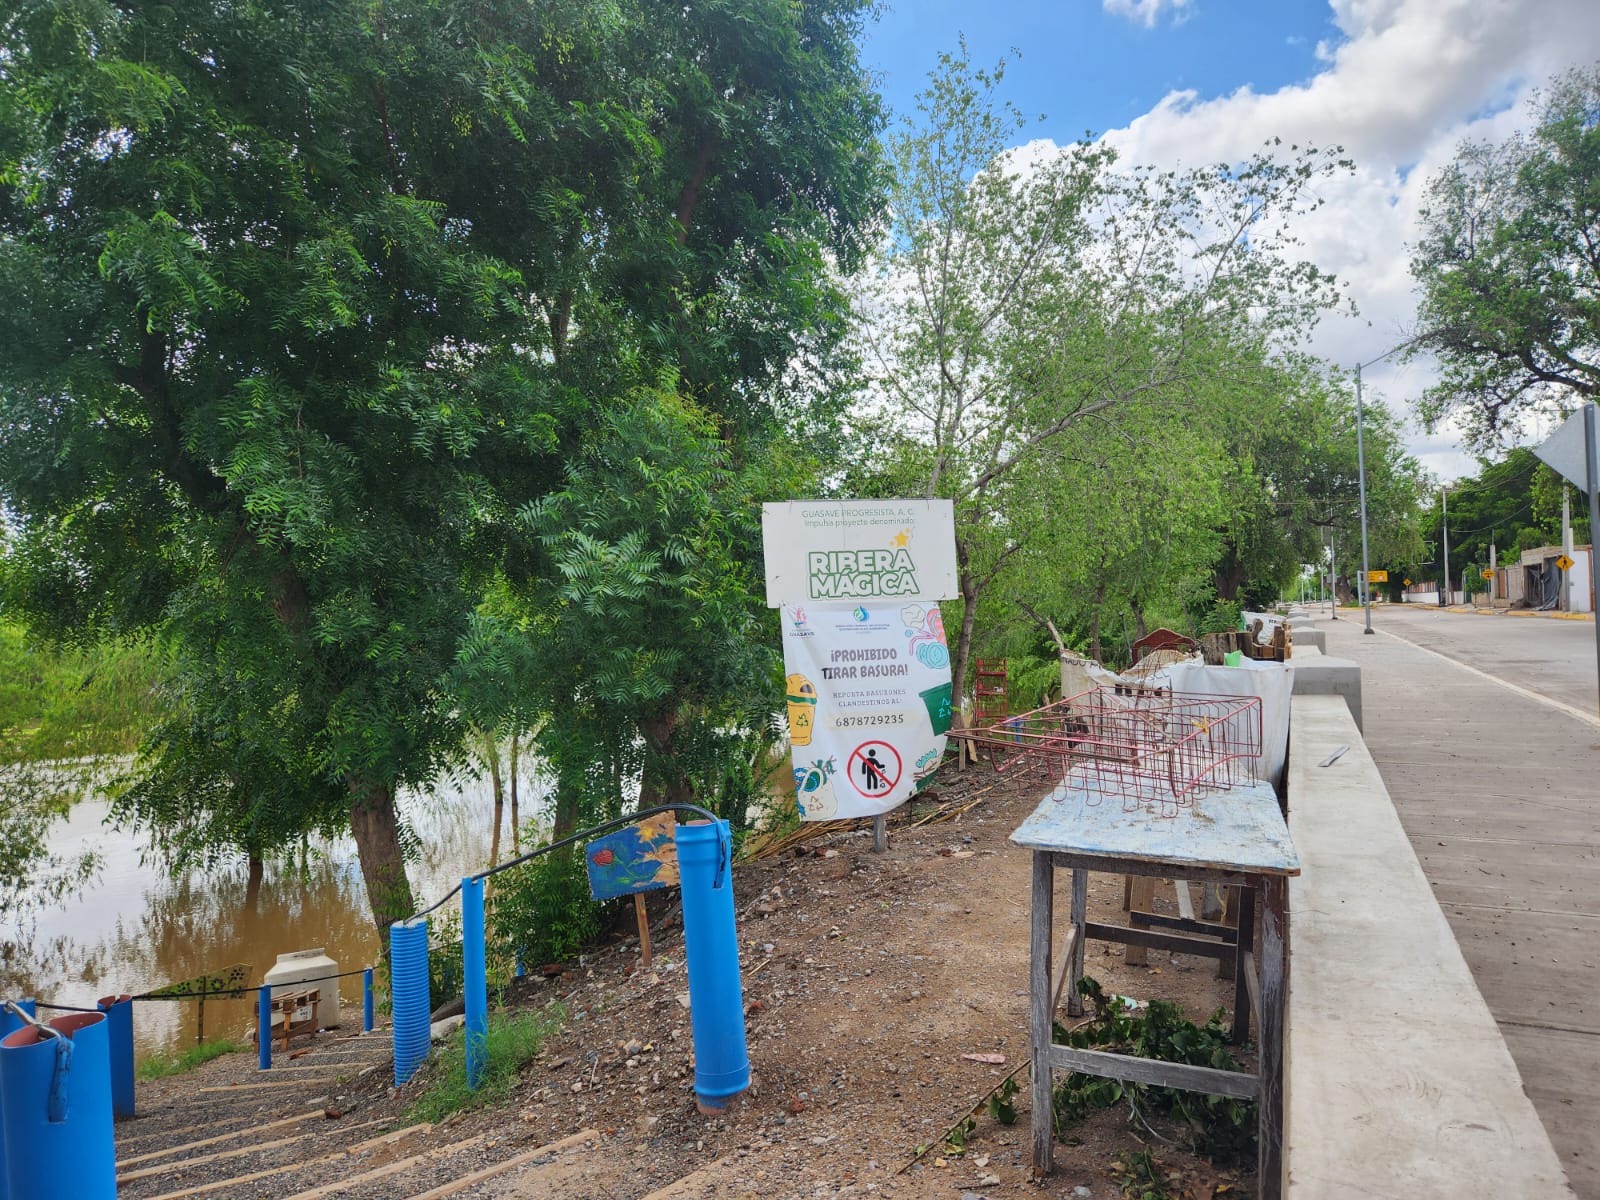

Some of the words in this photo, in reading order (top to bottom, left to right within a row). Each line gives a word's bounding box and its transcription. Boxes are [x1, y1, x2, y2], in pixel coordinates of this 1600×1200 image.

[801, 509, 840, 518] GUASAVE
[835, 519, 868, 528] proyecto
[809, 548, 916, 575] RIBERA
[831, 647, 897, 662] ¡PROHIBIDO
[821, 666, 858, 680] TIRAR
[860, 664, 908, 678] BASURA!
[833, 690, 865, 699] REPORTA
[866, 689, 906, 697] BASURONES
[838, 698, 890, 707] CLANDESTINOS
[836, 714, 904, 727] 6878729235
